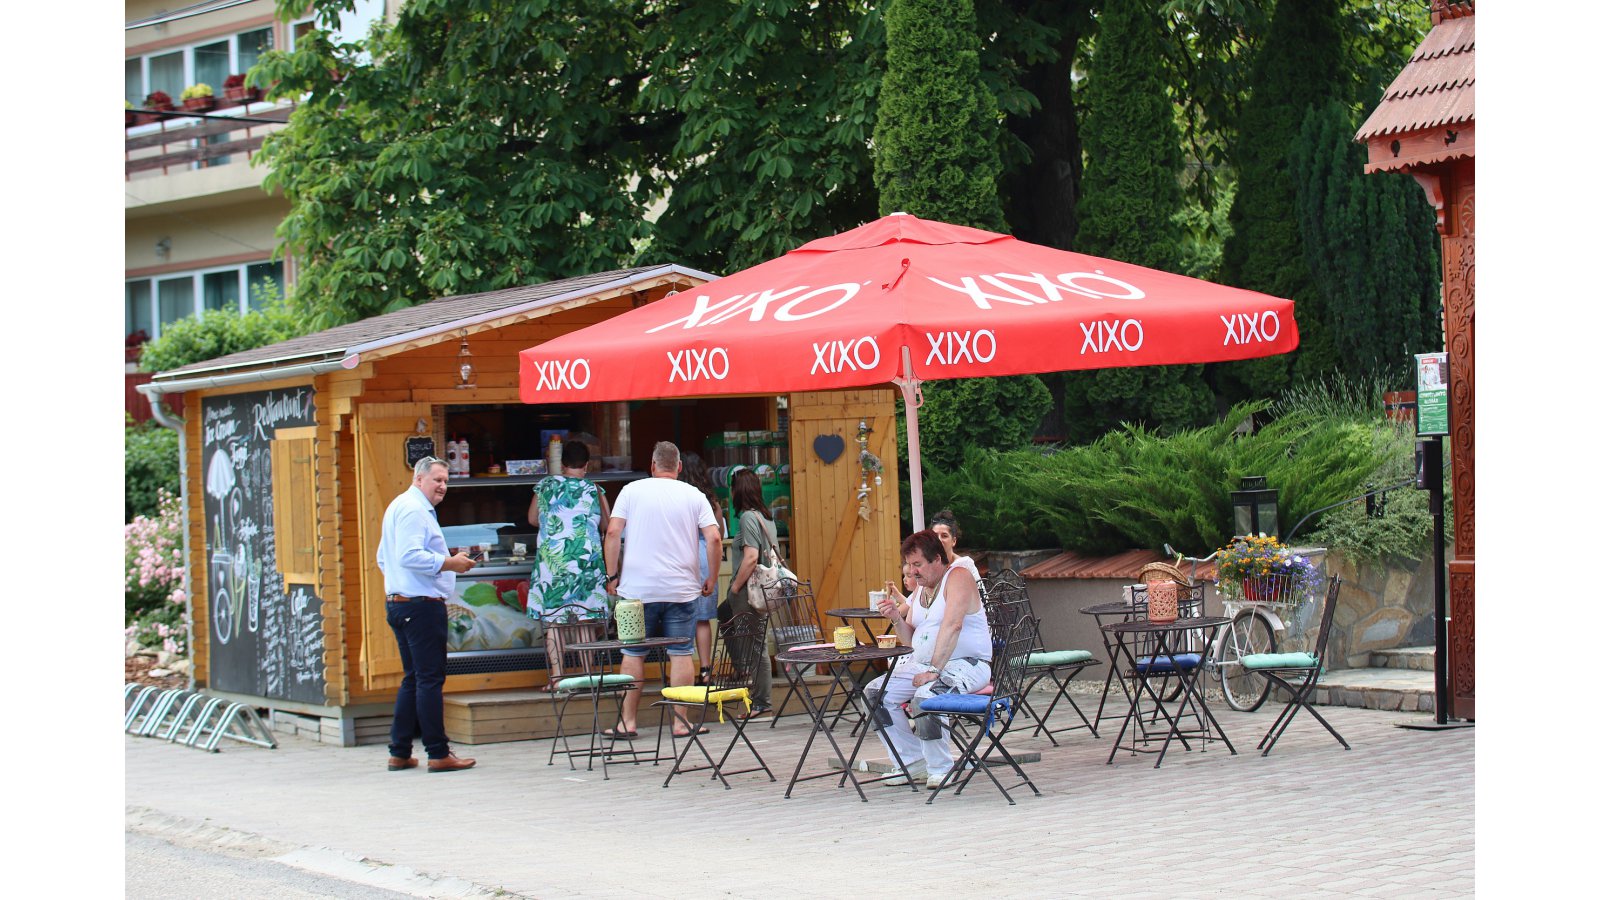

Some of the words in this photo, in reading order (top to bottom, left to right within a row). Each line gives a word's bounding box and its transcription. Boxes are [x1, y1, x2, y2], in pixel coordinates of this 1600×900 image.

[644, 282, 866, 334] XIXO
[927, 270, 1146, 310] XIXO
[1080, 319, 1143, 355] XIXO
[1220, 310, 1279, 346] XIXO
[667, 347, 729, 383] XIXO
[810, 336, 880, 375] XIXO
[925, 329, 996, 366] XIXO
[534, 358, 590, 391] XIXO
